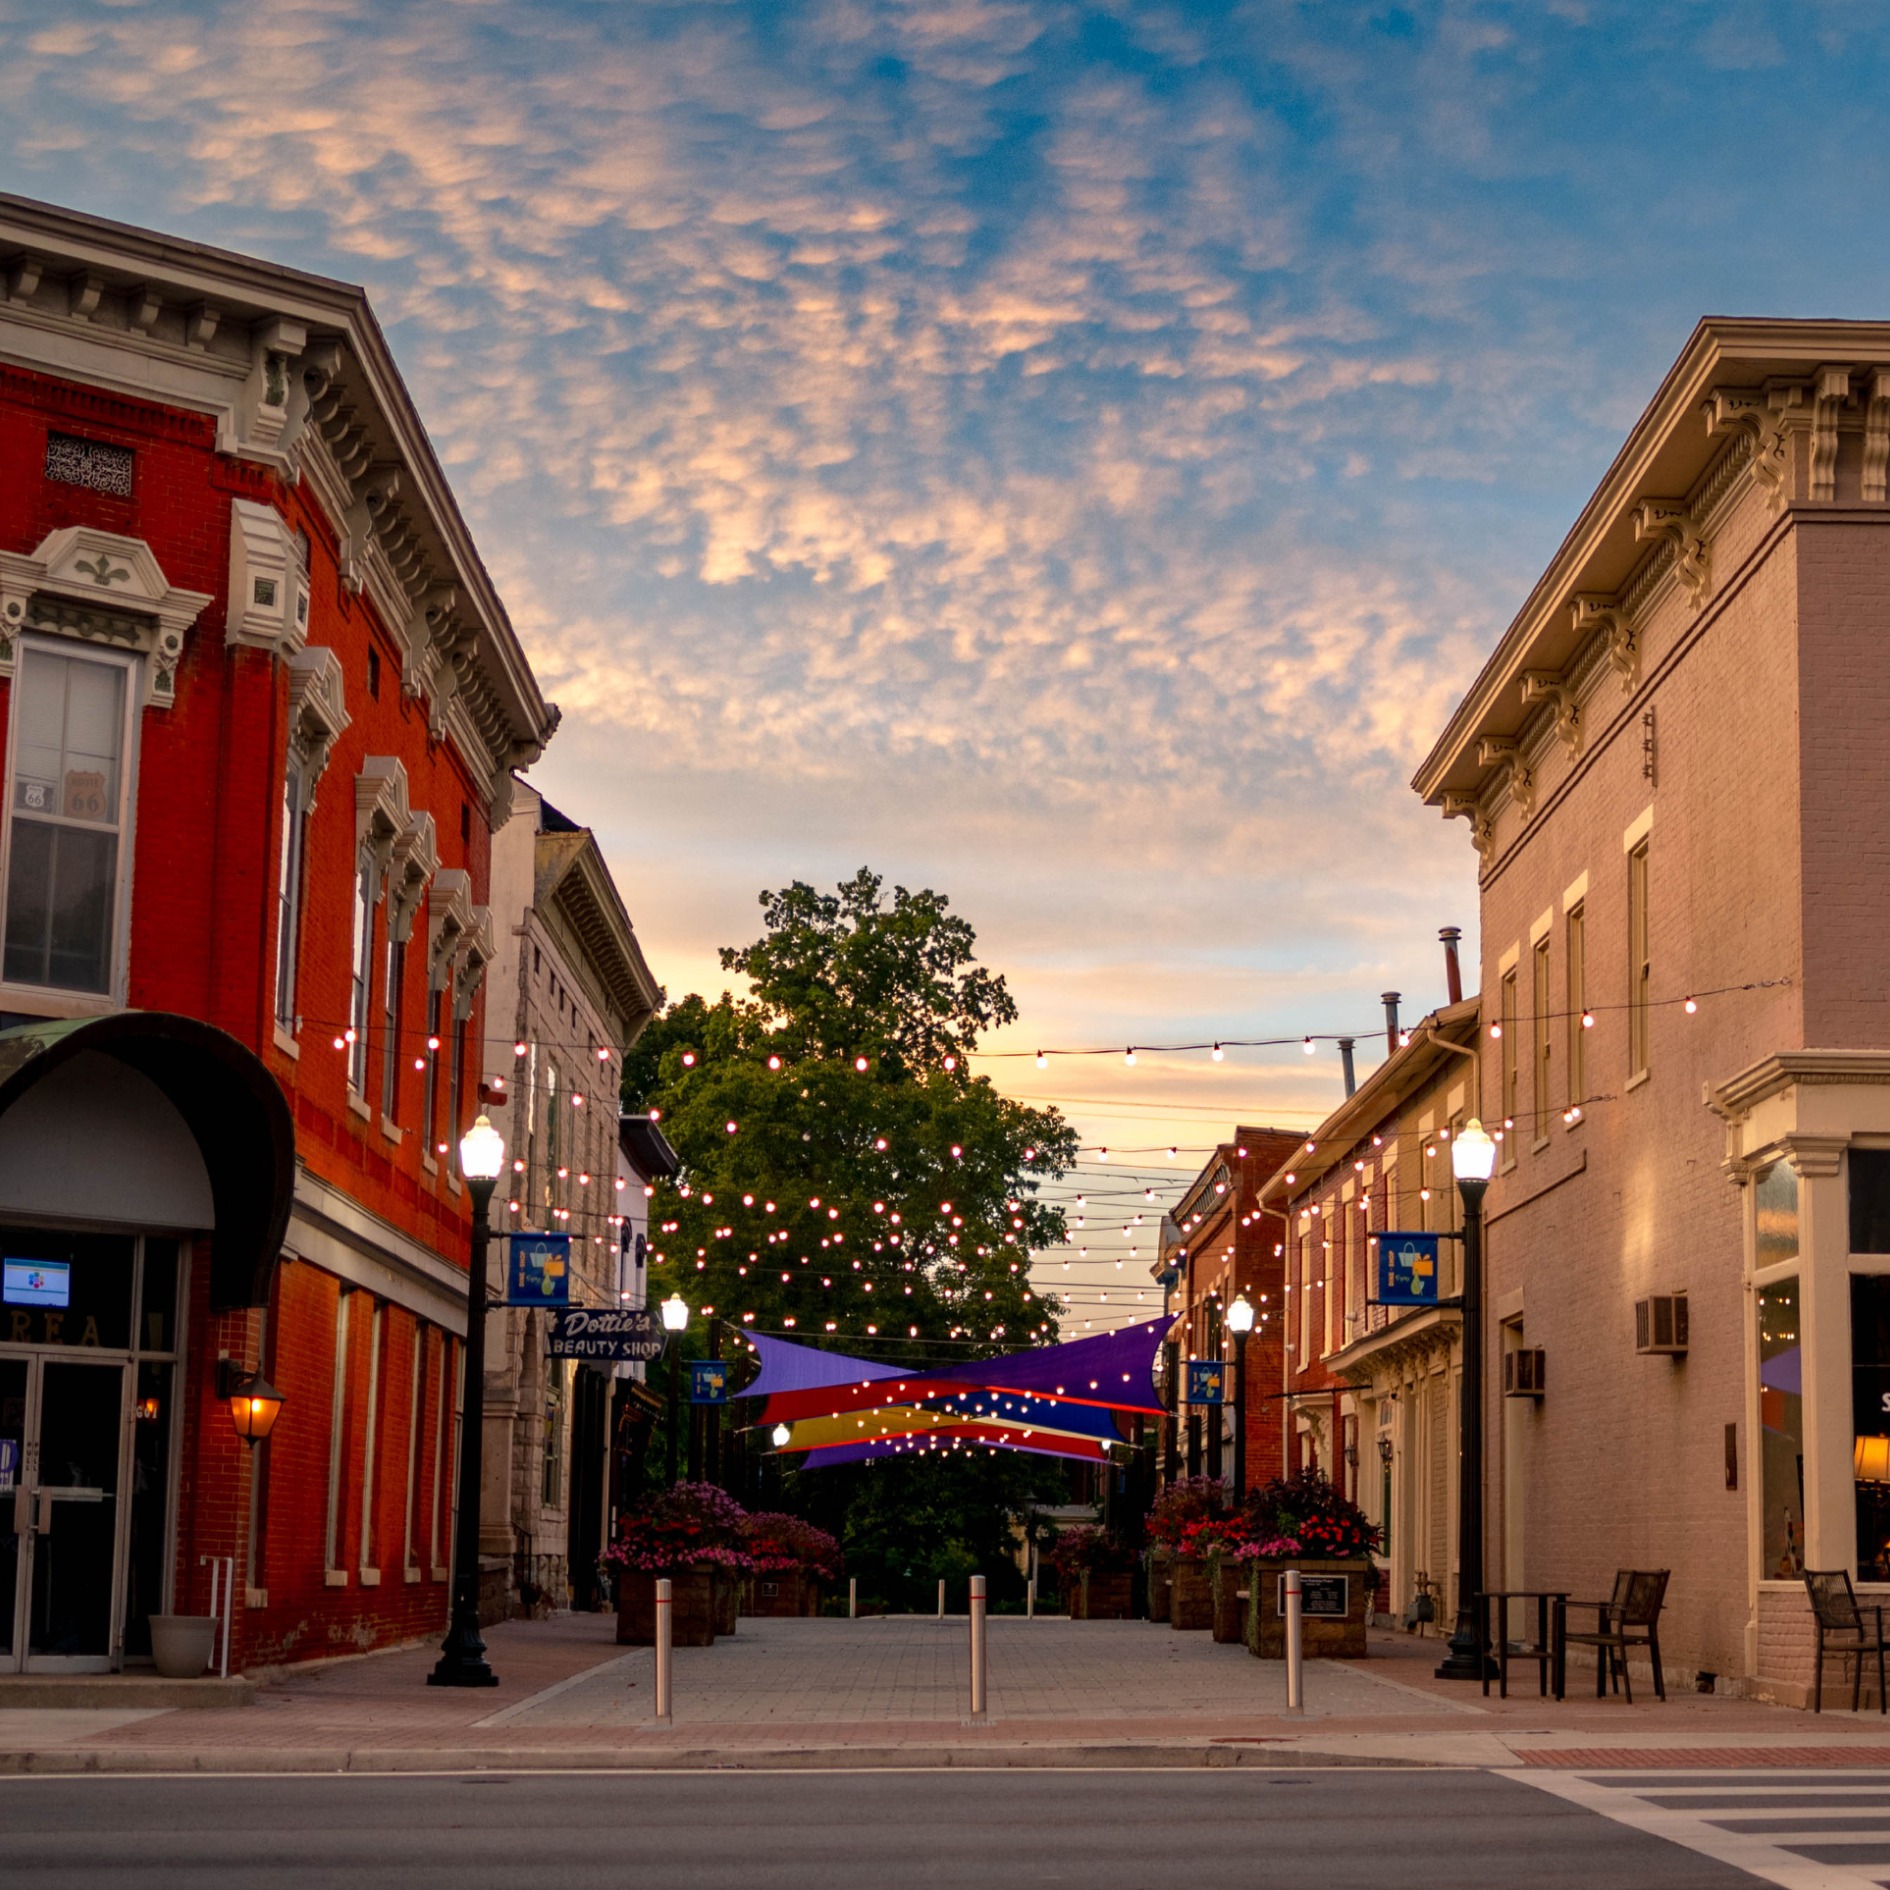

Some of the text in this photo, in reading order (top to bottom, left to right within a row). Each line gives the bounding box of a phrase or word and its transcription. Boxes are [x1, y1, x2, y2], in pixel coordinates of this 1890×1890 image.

[27, 793, 42, 806] 66
[72, 792, 99, 812] 66
[564, 1310, 650, 1337] Dottie's
[553, 1339, 661, 1357] BEAUTY SHOP
[136, 1405, 157, 1419] 601
